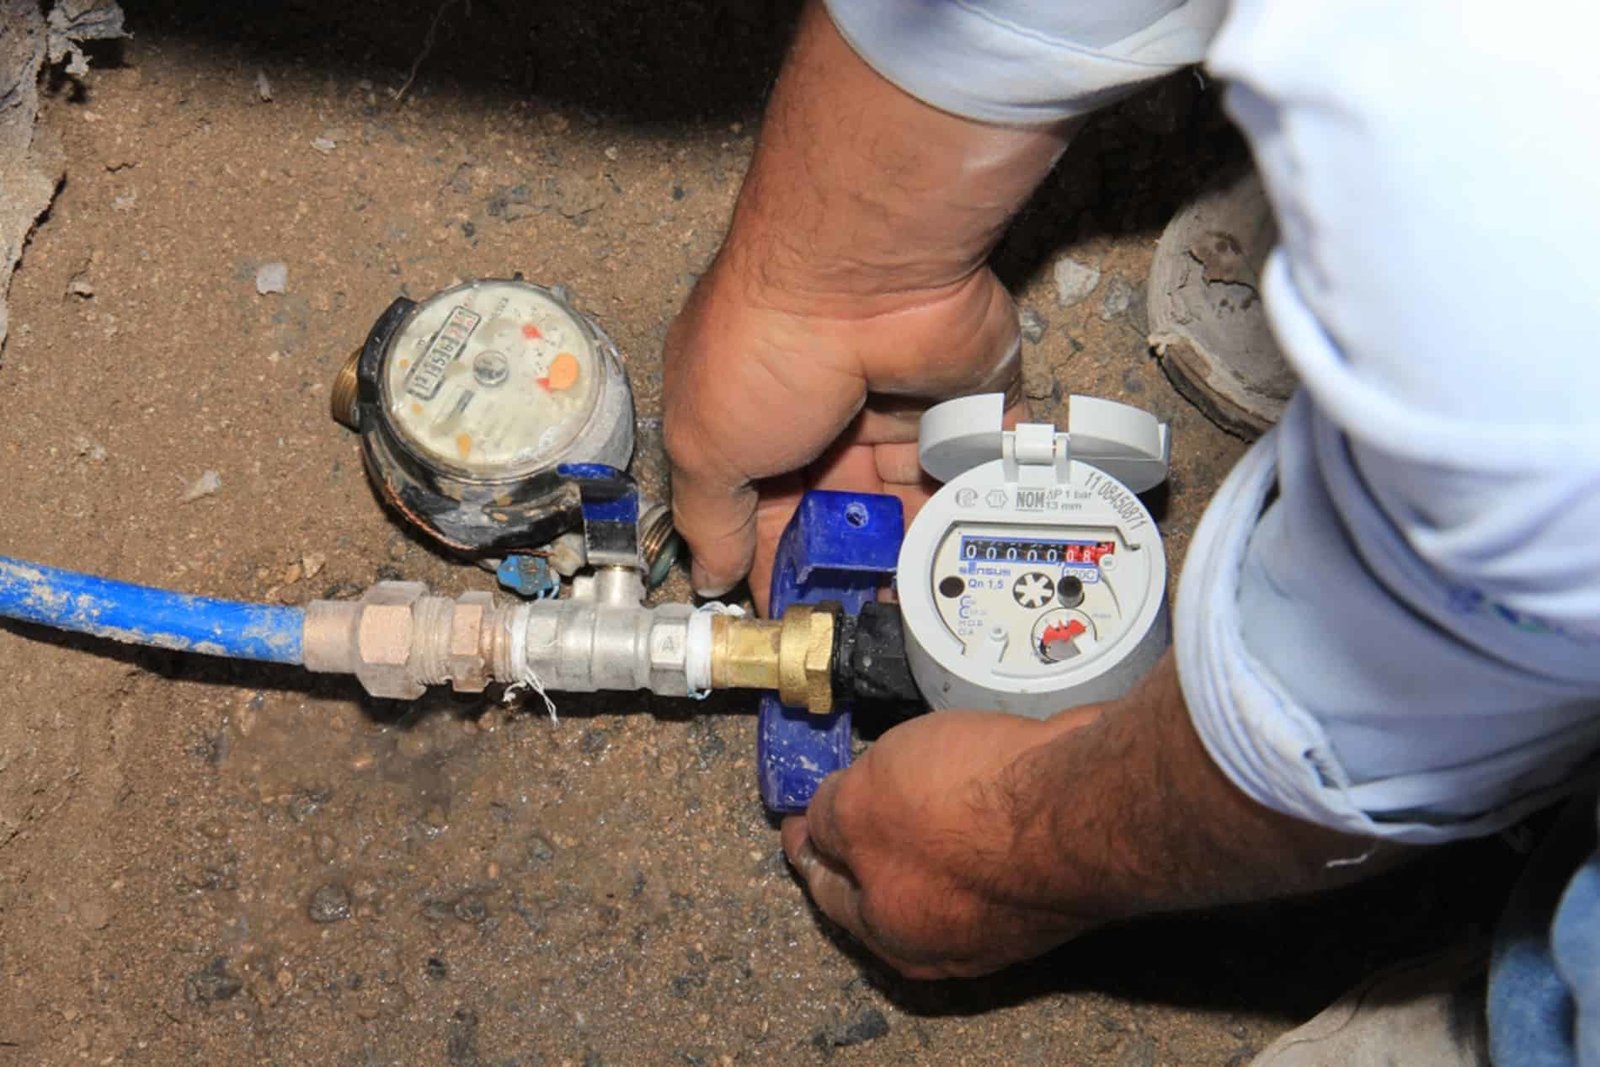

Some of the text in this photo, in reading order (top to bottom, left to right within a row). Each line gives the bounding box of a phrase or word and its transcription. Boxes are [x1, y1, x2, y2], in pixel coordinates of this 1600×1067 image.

[1074, 490, 1092, 499] bar
[1016, 491, 1045, 508] NOM
[1061, 503, 1083, 511] mm
